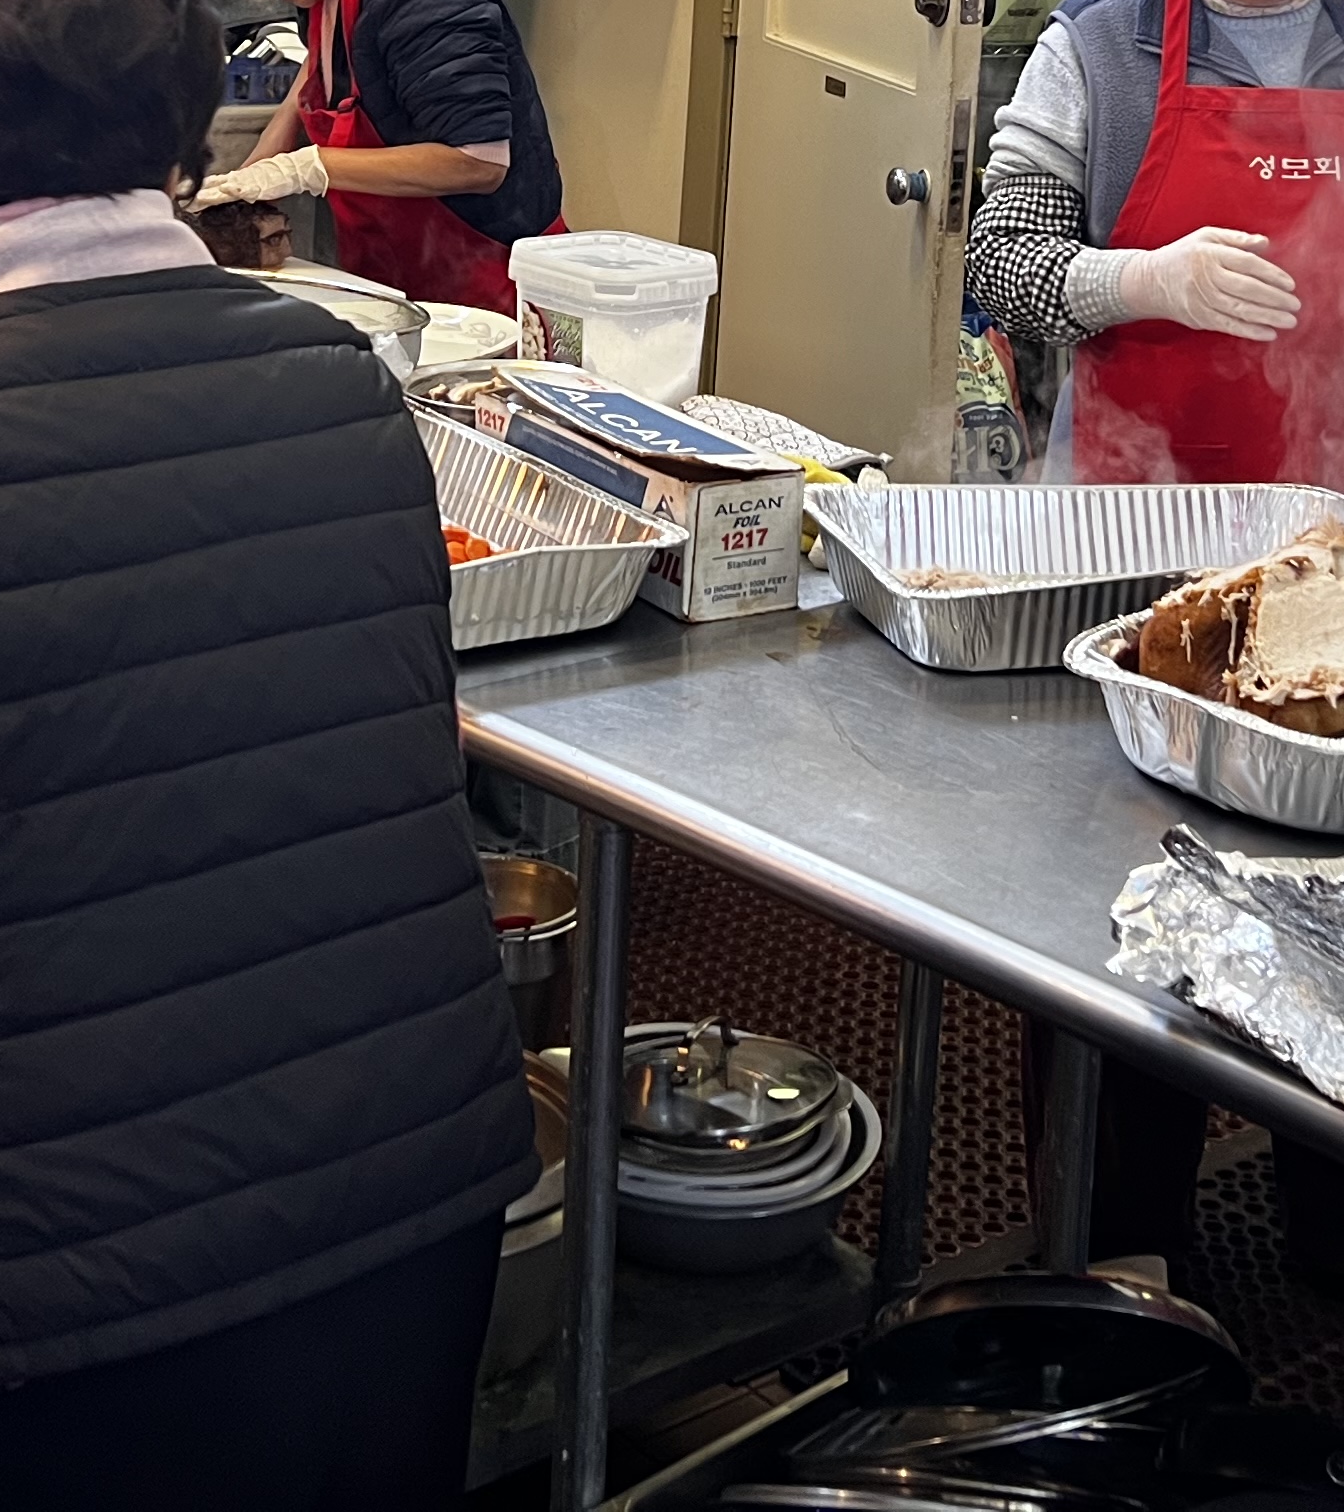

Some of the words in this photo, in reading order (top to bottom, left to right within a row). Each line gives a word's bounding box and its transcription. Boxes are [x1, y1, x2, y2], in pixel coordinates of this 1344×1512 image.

[1248, 154, 1341, 181] 성모회
[477, 406, 506, 433] 1217
[551, 386, 700, 454] ALCAN
[714, 496, 783, 517] ALCAN
[733, 514, 761, 529] FOIL
[721, 528, 769, 552] 1217
[648, 548, 682, 587] OIL
[727, 556, 767, 570] Standard
